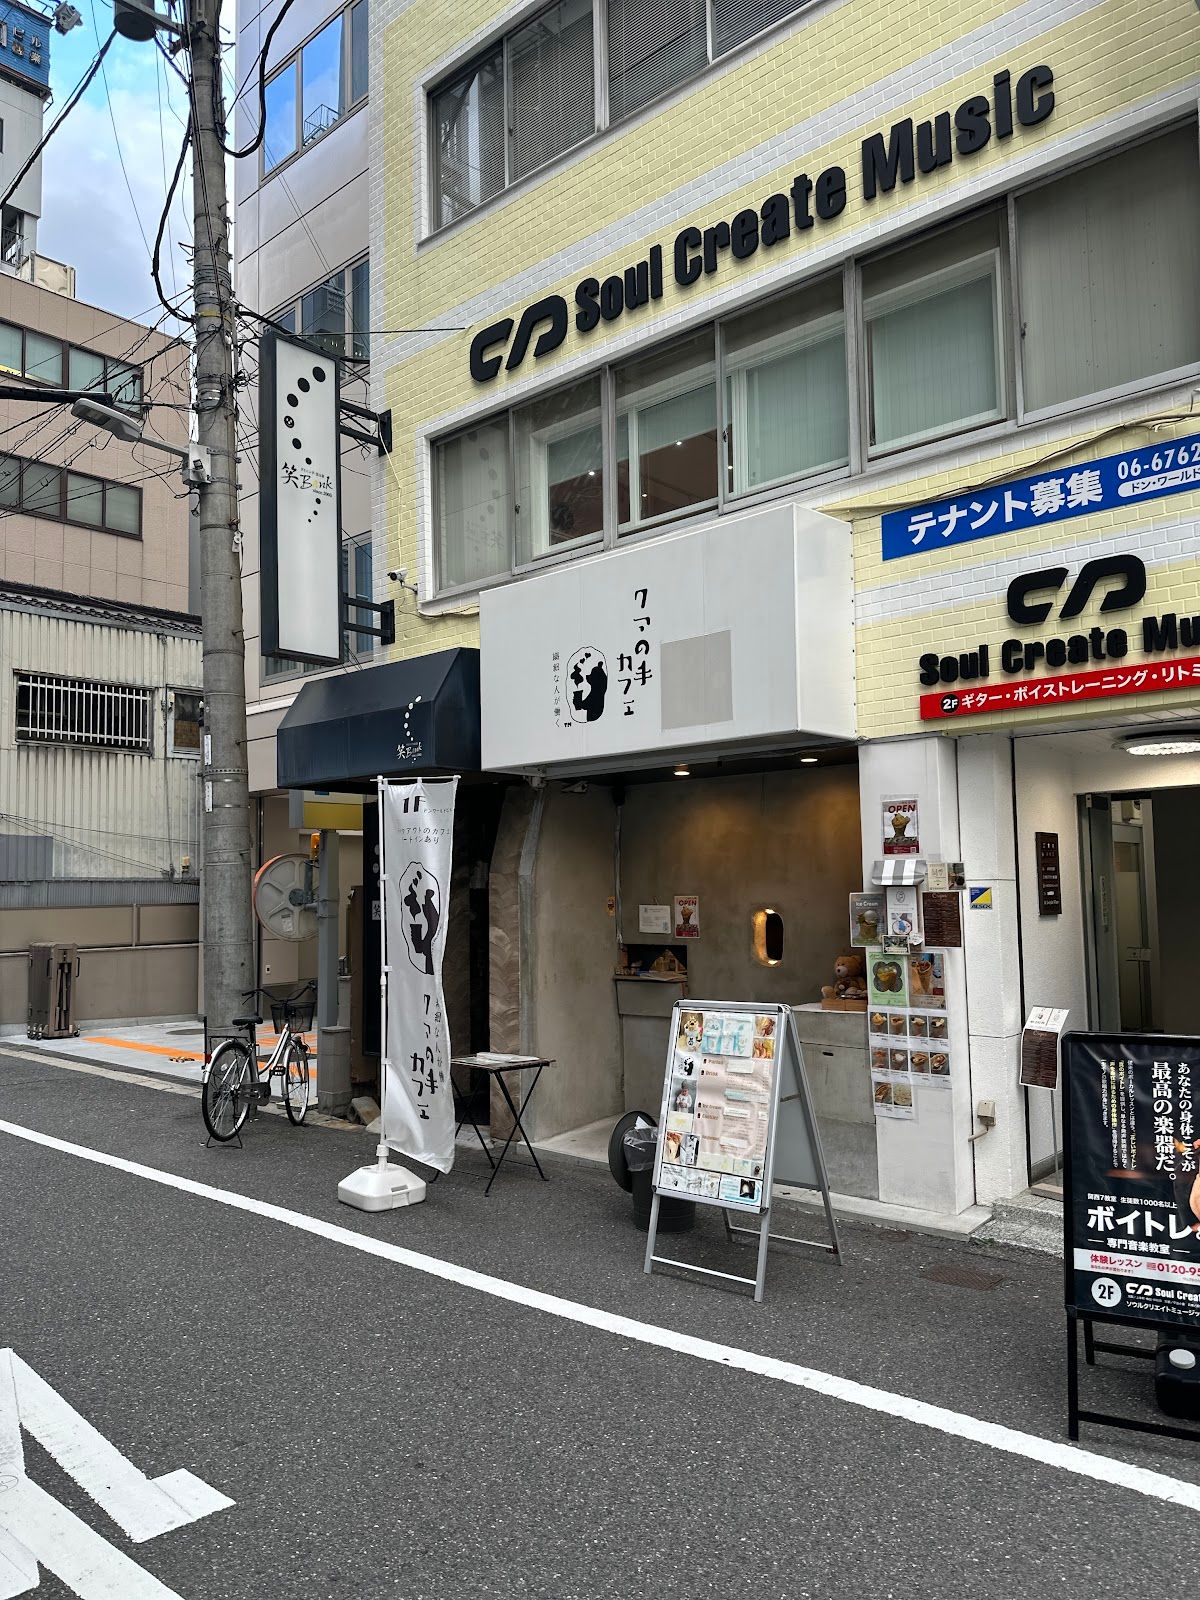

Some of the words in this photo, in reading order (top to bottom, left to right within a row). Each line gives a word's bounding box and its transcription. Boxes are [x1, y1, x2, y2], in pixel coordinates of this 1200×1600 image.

[575, 243, 663, 333] Soul
[674, 166, 847, 286] Create
[861, 64, 1055, 201] Music
[1117, 442, 1200, 480] 06-6762
[907, 469, 1103, 545] テナント募集
[919, 644, 990, 686] Soul
[1001, 626, 1128, 674] Create
[1142, 612, 1200, 653] Mu
[616, 653, 634, 716] カフェ
[942, 698, 959, 710] 2F
[403, 795, 426, 813] 1F
[888, 804, 916, 814] OPEN
[678, 899, 697, 907] OPEN
[410, 1052, 430, 1120] カフェ
[1151, 1061, 1177, 1181] 最高の楽器だ。
[1177, 1062, 1196, 1172] あなたの身体こそが
[1087, 1193, 1117, 1203] 関西7教室
[1120, 1197, 1178, 1209] 生徒数1000名以上
[1106, 1238, 1171, 1255] 専門音楽教室
[1090, 1253, 1143, 1268] 体験レッスン
[1098, 1284, 1114, 1300] 2F
[1155, 1287, 1175, 1299] Soul
